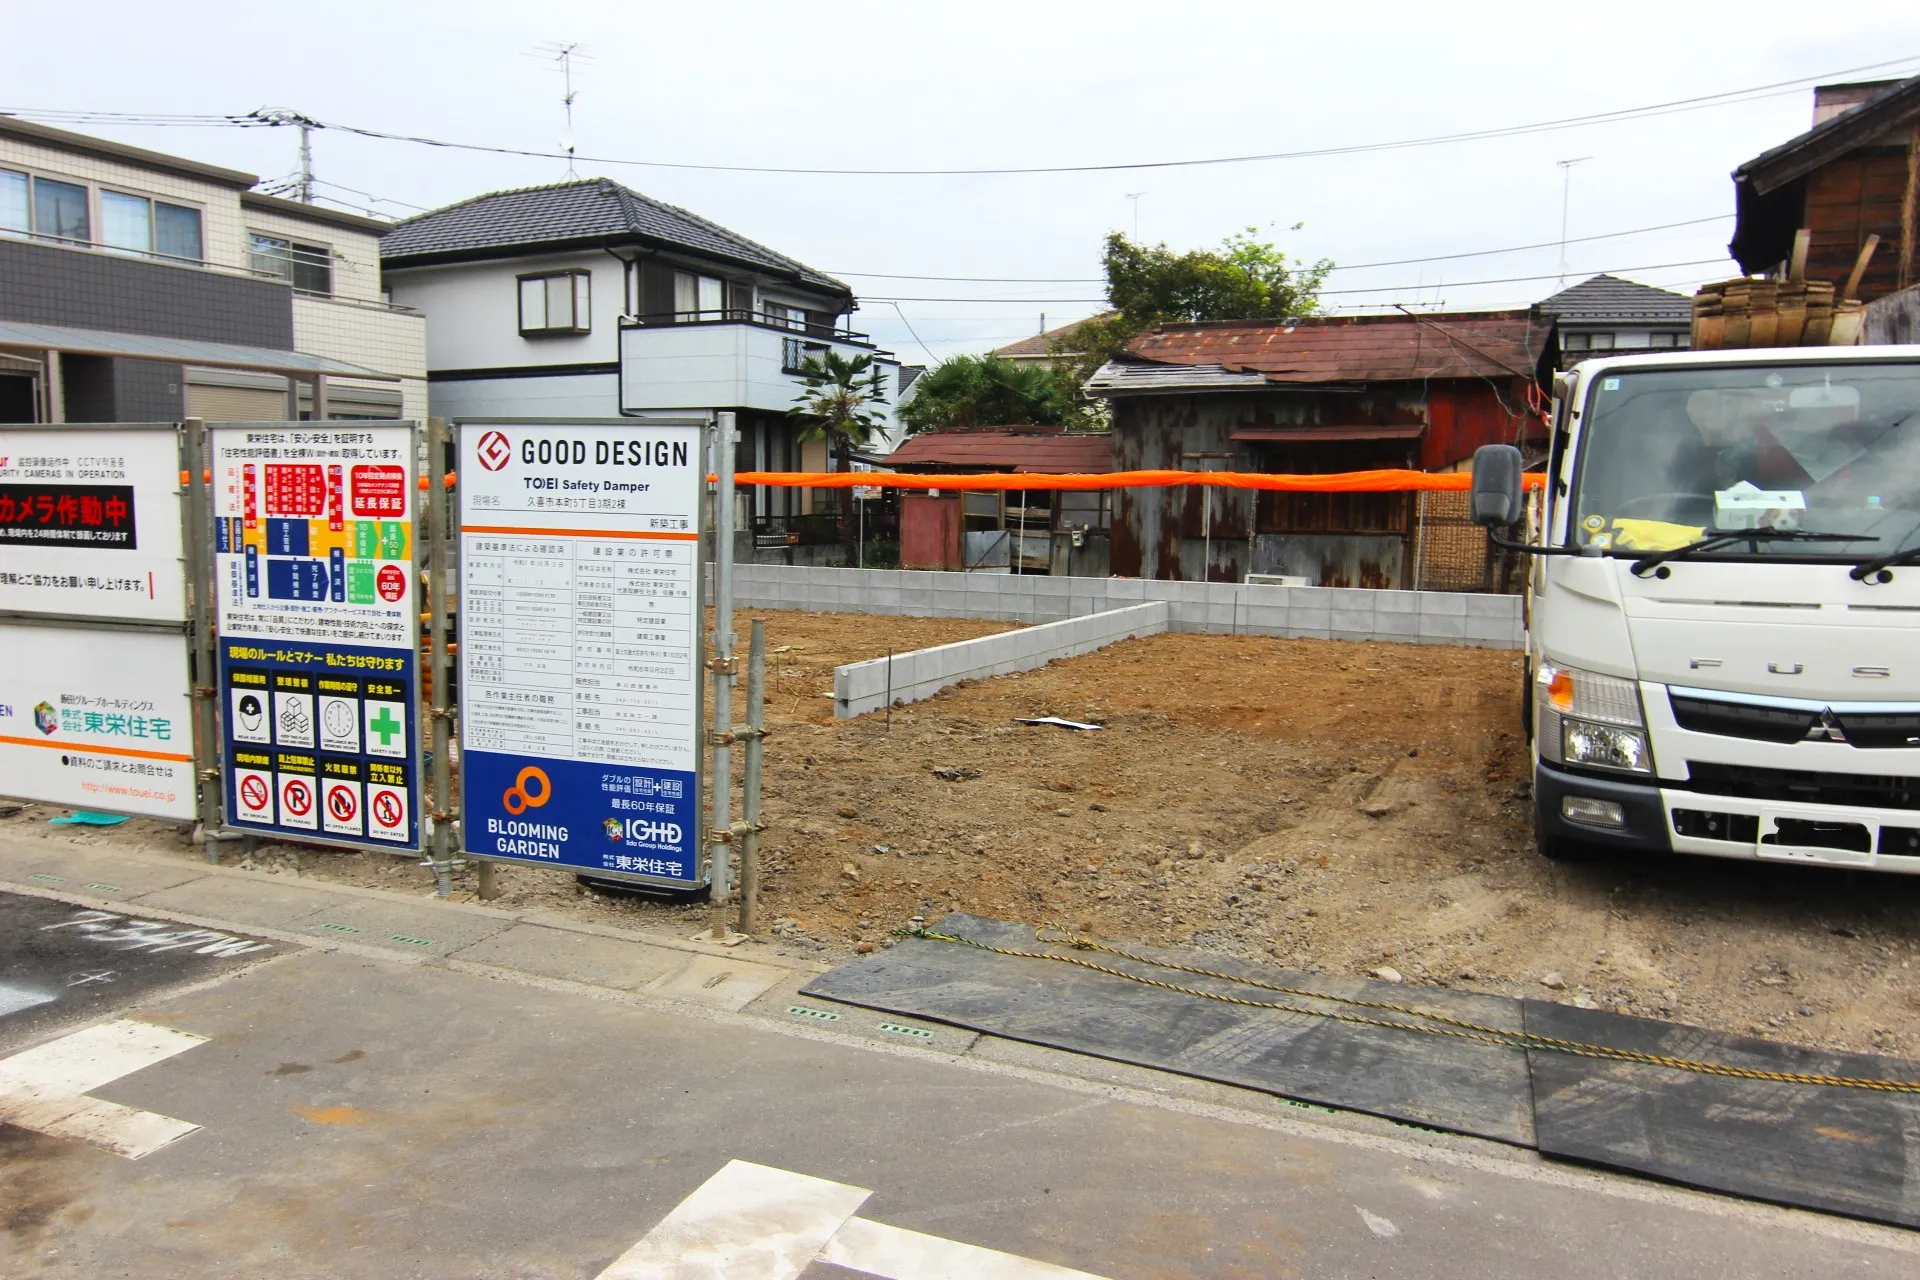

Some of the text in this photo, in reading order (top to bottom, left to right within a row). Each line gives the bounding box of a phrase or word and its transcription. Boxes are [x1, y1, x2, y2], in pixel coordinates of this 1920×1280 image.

[522, 439, 688, 467] GOOD DESIGN
[24, 470, 62, 478] CAMERAS
[66, 470, 74, 478] IN
[78, 470, 125, 479] OPERATION
[562, 479, 600, 493] Safety
[603, 481, 650, 493] Damper
[649, 518, 689, 530] 新築工事
[381, 582, 400, 592] 60年
[229, 646, 405, 670] 現場のルールとマナー 私たちは守ります
[368, 684, 401, 695] 安全第一
[61, 708, 83, 720] 株式
[61, 720, 83, 733] 会社
[84, 711, 172, 741] 東栄住宅
[601, 774, 631, 785] ダブルの
[601, 782, 632, 794] 性能評価
[611, 798, 676, 815] 最長60年保証
[487, 818, 569, 842] BLOOMING
[496, 837, 560, 859] GARDEN
[638, 840, 657, 850] Group
[657, 842, 683, 853] Holdings
[616, 855, 683, 877] 東栄住宅
